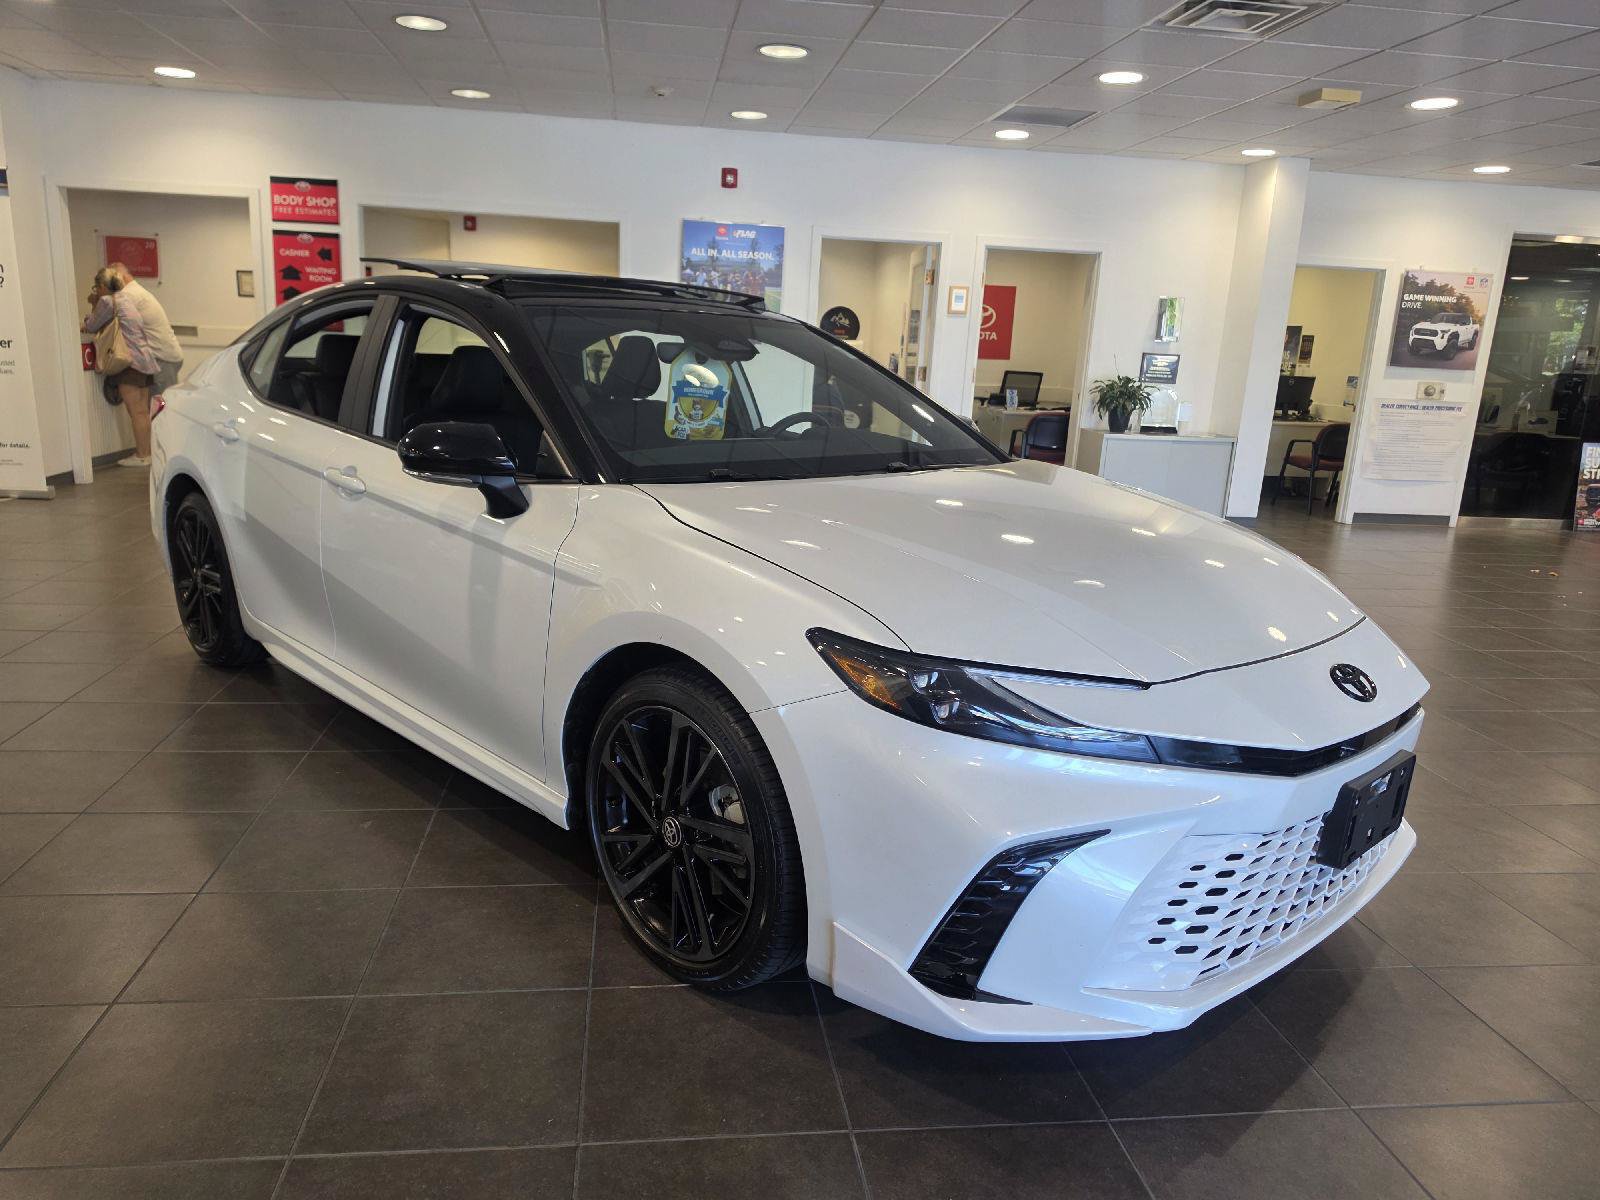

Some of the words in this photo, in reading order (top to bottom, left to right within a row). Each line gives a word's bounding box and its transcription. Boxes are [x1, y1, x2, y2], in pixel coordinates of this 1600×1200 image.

[273, 195, 304, 206] BODY
[306, 196, 337, 208] SHOP
[274, 206, 292, 214] FREE
[294, 207, 337, 216] ESTIMATES
[280, 248, 310, 257] CASHIER
[691, 248, 706, 256] ALL
[707, 248, 719, 257] IN.
[721, 249, 736, 258] ALL
[737, 251, 774, 260] SEASON.
[305, 266, 337, 275] WAITING
[1403, 293, 1424, 301] GAME
[1425, 295, 1457, 304] WINNING
[1401, 301, 1422, 309] DRIVE.
